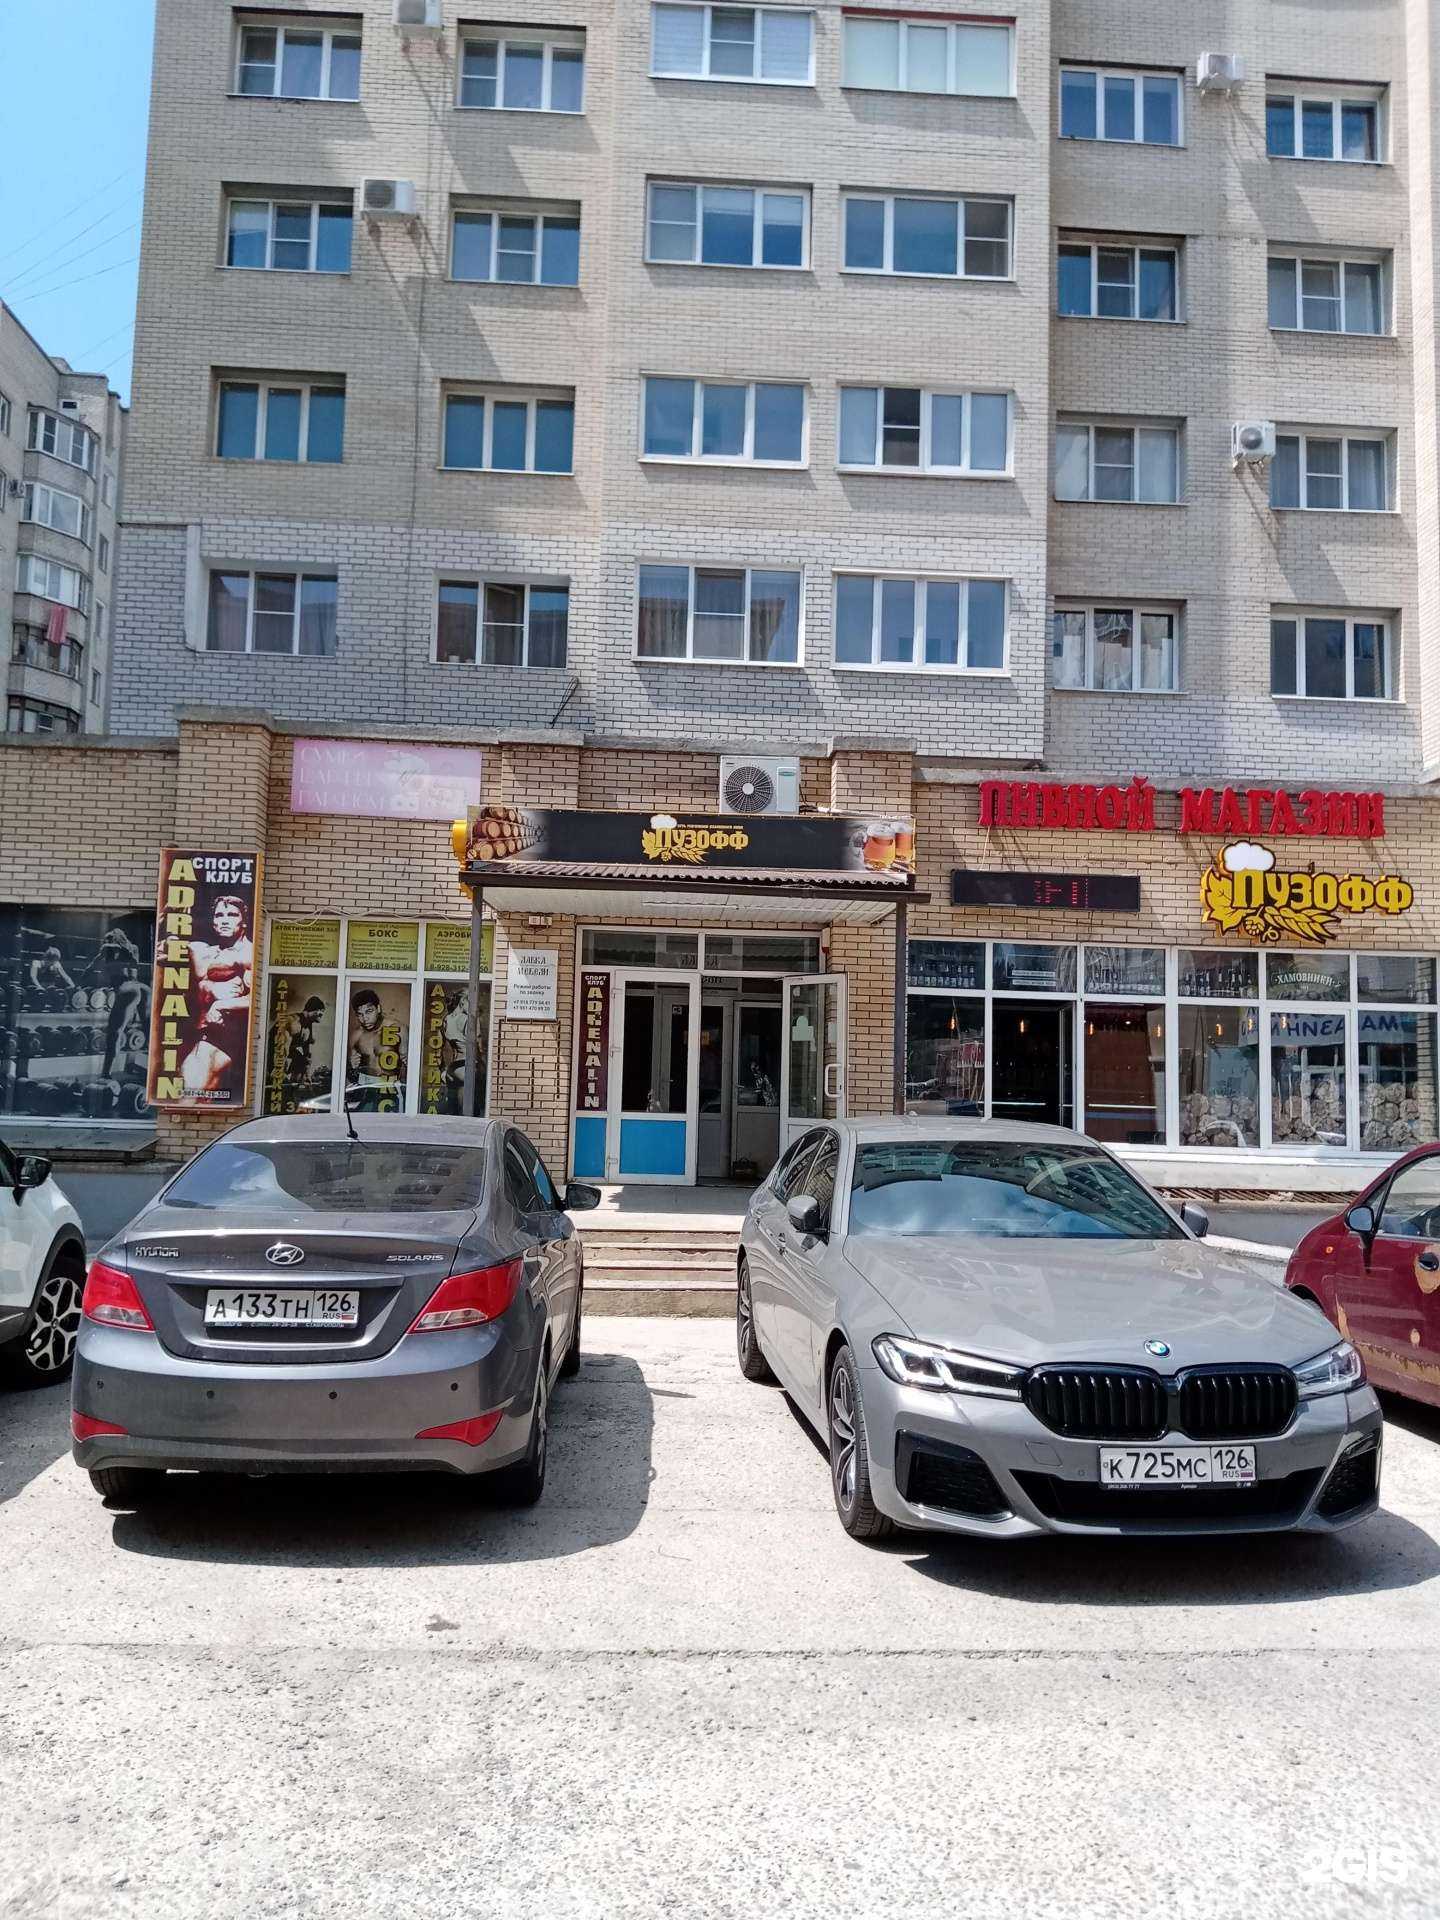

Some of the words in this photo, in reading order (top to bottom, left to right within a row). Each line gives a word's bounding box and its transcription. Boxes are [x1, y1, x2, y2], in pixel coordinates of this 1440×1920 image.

[978, 776, 1156, 832] ПИВНОЙ
[1178, 787, 1386, 839] МАГАЗИН
[192, 857, 254, 871] СПОРТ
[206, 871, 253, 884] КЛУБ
[368, 929, 399, 938] БОКС
[156, 858, 197, 1099] ADRENALIN
[584, 987, 603, 1108] ADRENALIN
[377, 1025, 400, 1113] БОКС
[135, 1246, 179, 1257] HYUNDAI
[386, 1254, 445, 1262] SOLARIS
[213, 1293, 309, 1319] А133ТН
[316, 1292, 351, 1312] 126
[323, 1312, 342, 1320] RUS
[1109, 1452, 1207, 1479] К725МС
[1214, 1449, 1250, 1470] 126
[1222, 1470, 1241, 1479] RUS
